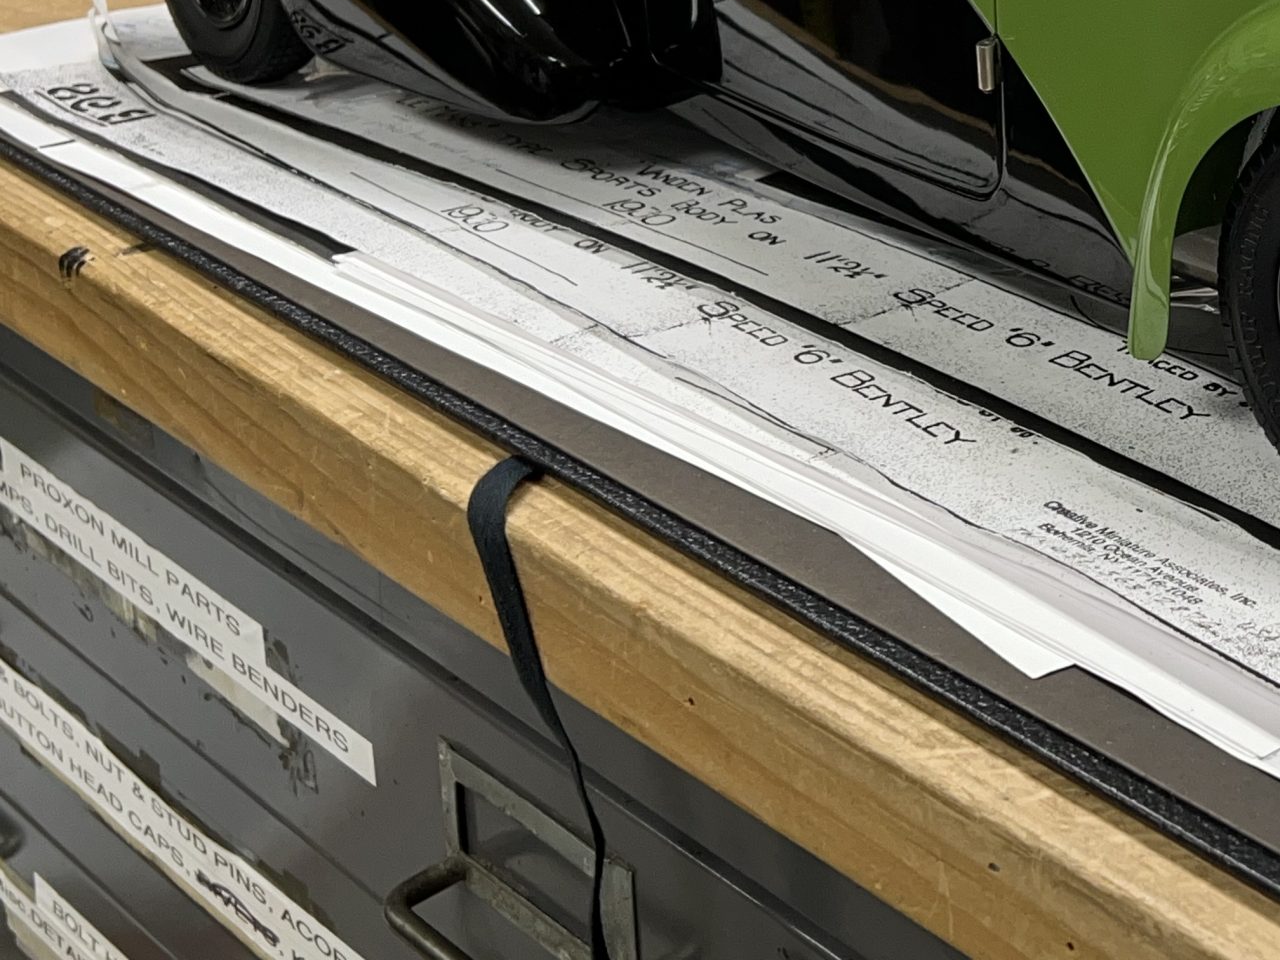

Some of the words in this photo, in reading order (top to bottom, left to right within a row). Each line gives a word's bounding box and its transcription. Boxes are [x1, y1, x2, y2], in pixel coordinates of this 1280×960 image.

[637, 161, 713, 196] VANDEN
[718, 198, 784, 225] PLAS
[560, 158, 661, 197] SPORTS
[671, 199, 739, 226] BODY
[748, 230, 786, 246] ON
[893, 288, 995, 332] SPEED
[1048, 349, 1212, 420] BENTLEY
[574, 237, 610, 254] ON
[696, 300, 789, 347] SPEED
[830, 369, 977, 444] BENTLEY
[1203, 381, 1238, 397] BY
[20, 462, 104, 536] PROXON
[111, 528, 159, 576] MILL
[166, 571, 241, 636] PARTS
[1096, 523, 1156, 559] Miniature
[1103, 543, 1148, 567] Ocean
[1149, 566, 1200, 592] Avenue
[45, 516, 102, 565] DRILL
[107, 561, 160, 613] BITS,
[166, 603, 224, 660] WIRE
[232, 652, 349, 753] BENDERS
[14, 680, 80, 747] BOLTS,
[86, 742, 125, 782] NUT
[132, 783, 145, 802] &
[151, 798, 207, 855] STUD
[214, 851, 273, 912] PINS,
[70, 758, 122, 812] HEAD
[129, 811, 190, 876] CAPS,
[53, 900, 99, 951] BOLT
